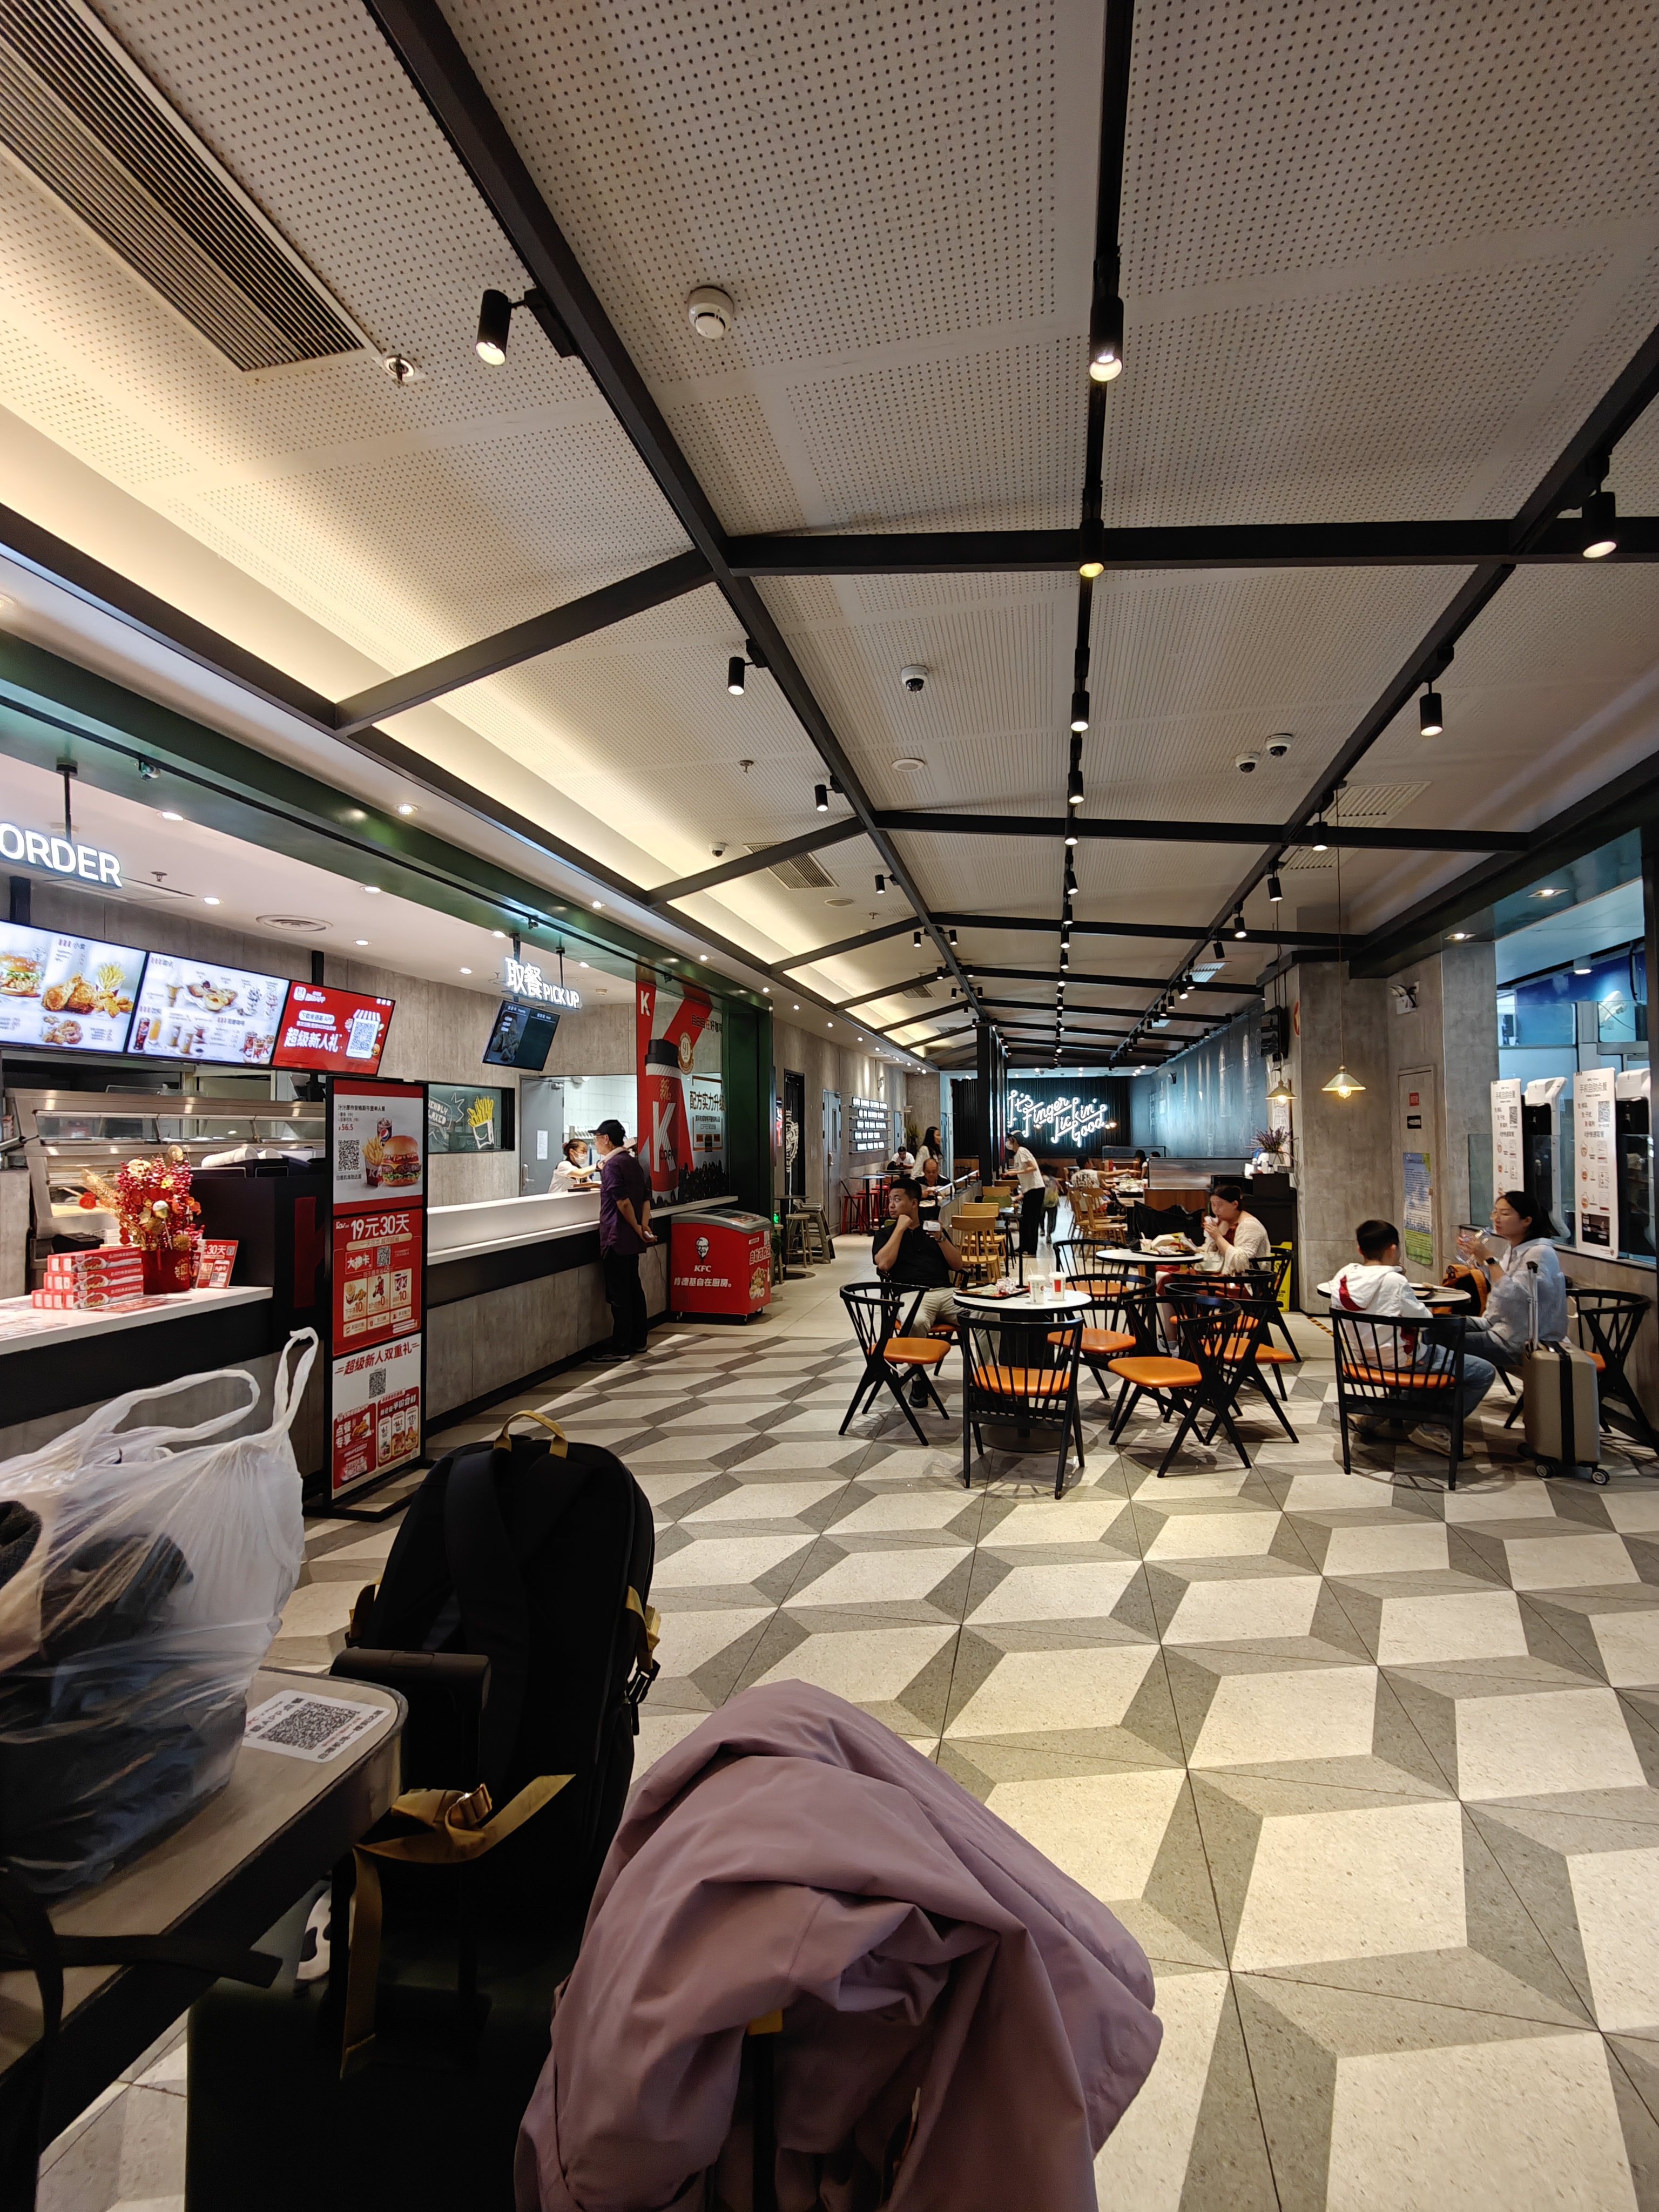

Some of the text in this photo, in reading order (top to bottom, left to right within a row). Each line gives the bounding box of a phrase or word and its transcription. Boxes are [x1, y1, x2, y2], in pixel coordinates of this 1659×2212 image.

[0, 822, 122, 888] ORDER
[505, 956, 579, 1008] 取餐 PICK UP
[640, 990, 651, 1016] K
[284, 1026, 339, 1053] 超级新人礼
[682, 1042, 689, 1057] 91
[428, 1100, 448, 1116] IENDLY
[690, 1091, 726, 1111] 配方实力升级
[428, 1109, 446, 1124] LAXED
[1022, 1097, 1072, 1138] Finger
[652, 1101, 676, 1172] K
[351, 1213, 409, 1240] 19元30天
[674, 1277, 732, 1287] 肯德基自在厨房。
[343, 1341, 412, 1376] 超级新人双重礼
